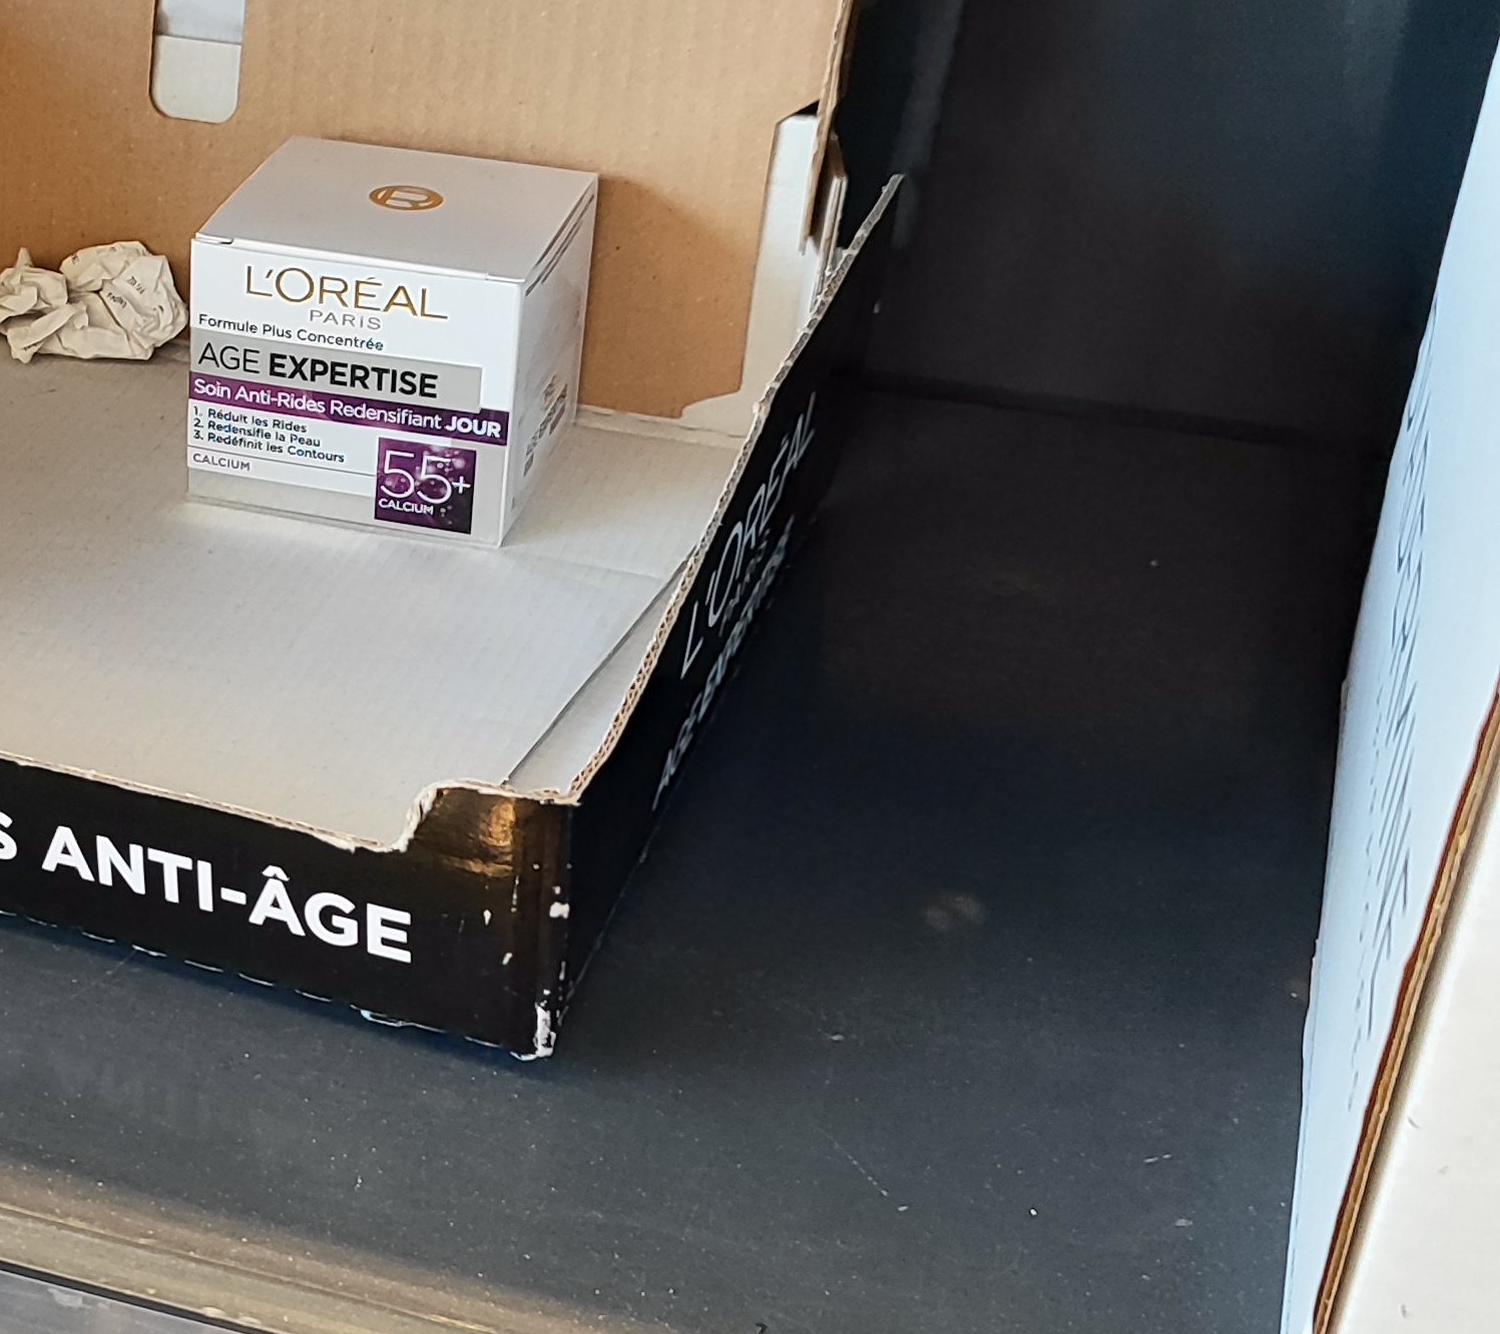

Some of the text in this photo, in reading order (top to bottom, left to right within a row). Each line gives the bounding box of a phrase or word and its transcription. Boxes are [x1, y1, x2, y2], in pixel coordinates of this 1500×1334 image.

[246, 265, 448, 320] L'ORÉAL
[198, 313, 384, 352] Formule Plus Concentrée
[309, 309, 382, 330] PARIS
[198, 341, 438, 398] AGE EXPERTISE
[193, 406, 308, 434] 1. Réduit les Rides
[194, 378, 502, 439] Soin Anti-Rides Redensifiant JOUR
[193, 418, 321, 448] 2. Redensifie la Peau
[193, 430, 345, 464] 3. Redéfinit les Contours
[192, 452, 251, 472] CALCIUM
[380, 449, 472, 505] 55+
[378, 498, 434, 515] CALCIUM
[41, 825, 413, 965] ANTI-ÂGE
